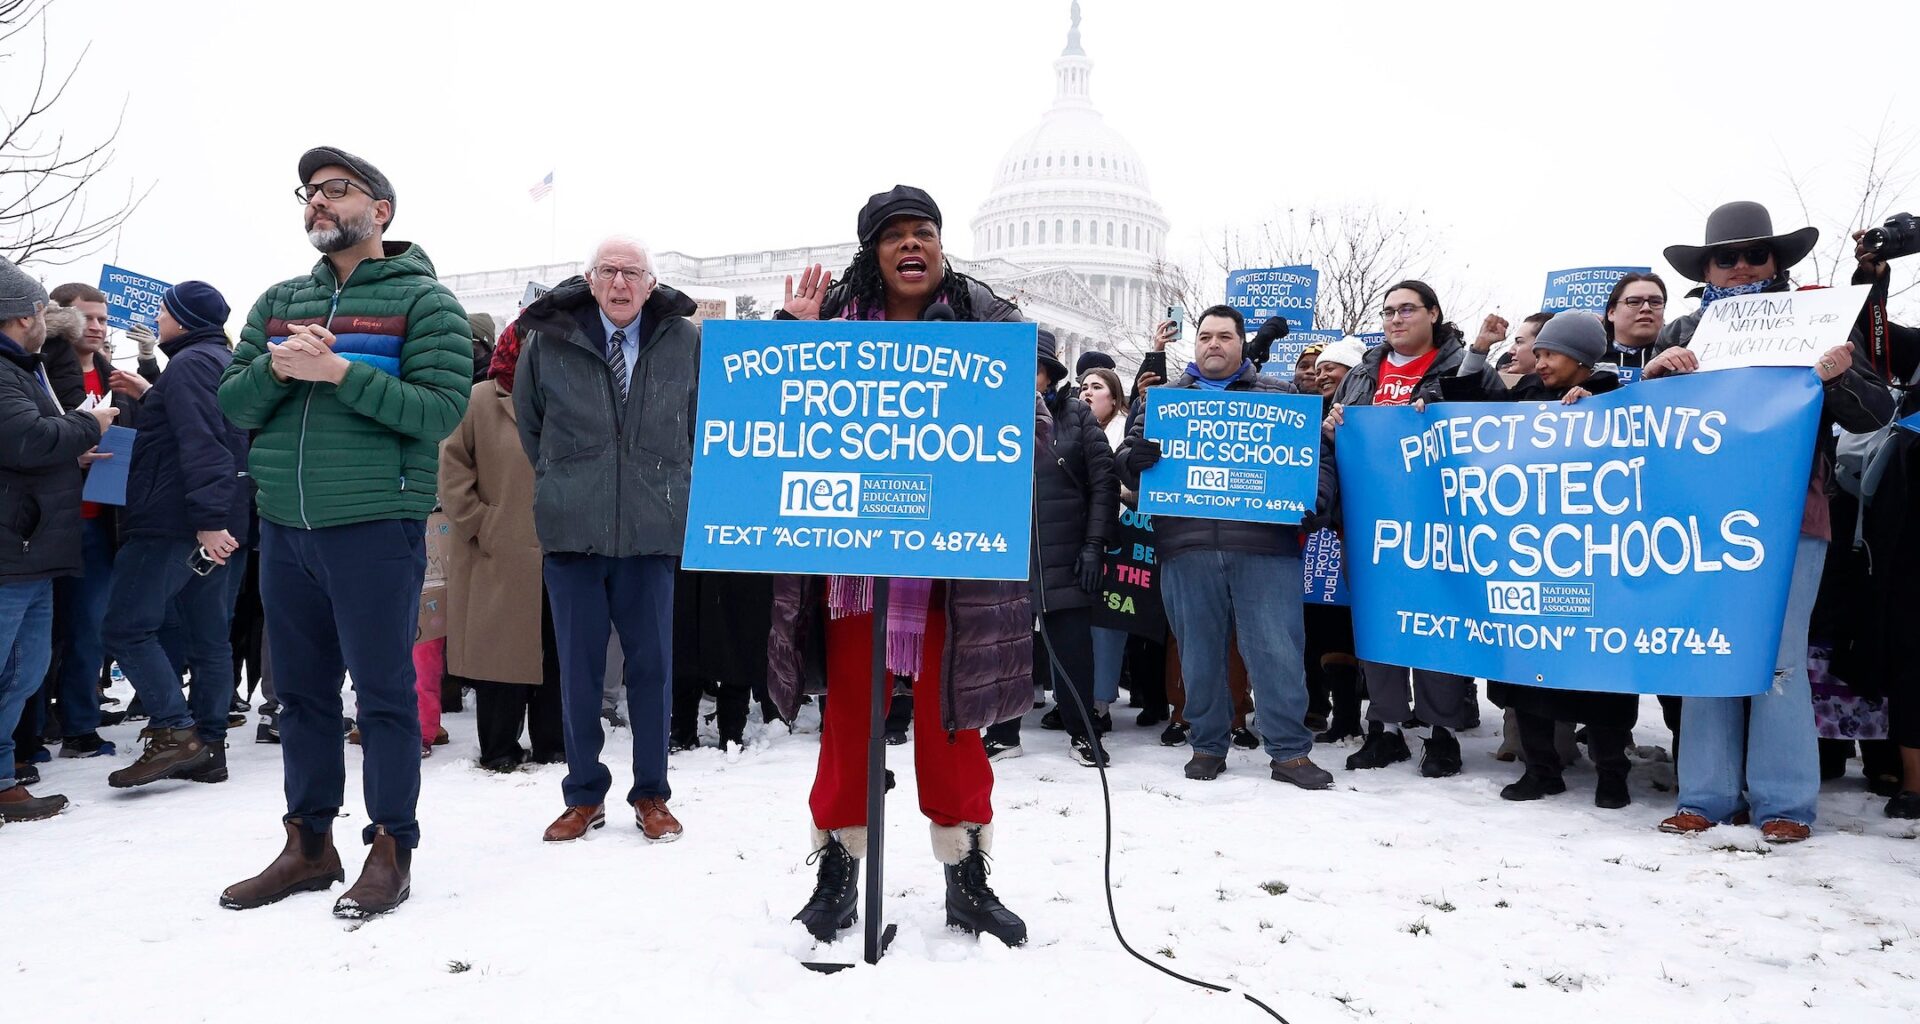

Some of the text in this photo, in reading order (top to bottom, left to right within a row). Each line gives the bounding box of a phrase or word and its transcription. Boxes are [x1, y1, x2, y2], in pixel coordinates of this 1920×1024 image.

[109, 273, 149, 288] PROTECT
[1235, 272, 1312, 287] PROTECT STUDENTS
[1246, 283, 1292, 296] PROTECT
[1553, 270, 1627, 287] PROTECT STUDE
[1566, 282, 1617, 295] PROTEC
[1228, 296, 1313, 309] PUBLIC SCHOOLS
[1543, 296, 1584, 309] PUBLIC
[1709, 298, 1793, 323] MONTANA
[1728, 316, 1795, 333] NATIVES
[1700, 336, 1818, 362] EDUCATION
[723, 341, 1007, 388] PROTECT STUDENTS
[780, 379, 948, 418] PROTECT
[1157, 401, 1307, 429] PROTECT STUDENTS
[703, 420, 1022, 463] PUBLIC SCHOOLS
[1187, 419, 1275, 443] PROTECT
[1530, 405, 1727, 455] STUDENTS
[1217, 442, 1313, 467] SCHOOLS
[863, 480, 926, 491] NATIONAL
[1190, 469, 1226, 488] nea
[1230, 471, 1264, 479] NATIONAL
[1440, 456, 1645, 517] PROTECT
[785, 478, 853, 512] nea
[863, 492, 926, 503] EDUCATION
[1148, 491, 1305, 512] TEXT "ACTION" TO 48744
[861, 503, 926, 514] ASSOCIATION
[704, 525, 1008, 552] TEXT "ACTION" TO 48744
[1372, 510, 1765, 579] PUBLIC SCHOOLS
[1116, 564, 1151, 588] THE
[1303, 553, 1314, 594] PROTECT
[1323, 560, 1340, 603] PUBLIC
[1490, 586, 1537, 612] nea
[1542, 587, 1591, 596] NATIONAL
[1542, 596, 1591, 605] EDUCATION
[1543, 605, 1591, 613] ASSOCIATION
[1396, 610, 1732, 655] TEXT "ACTION" TO 48744
